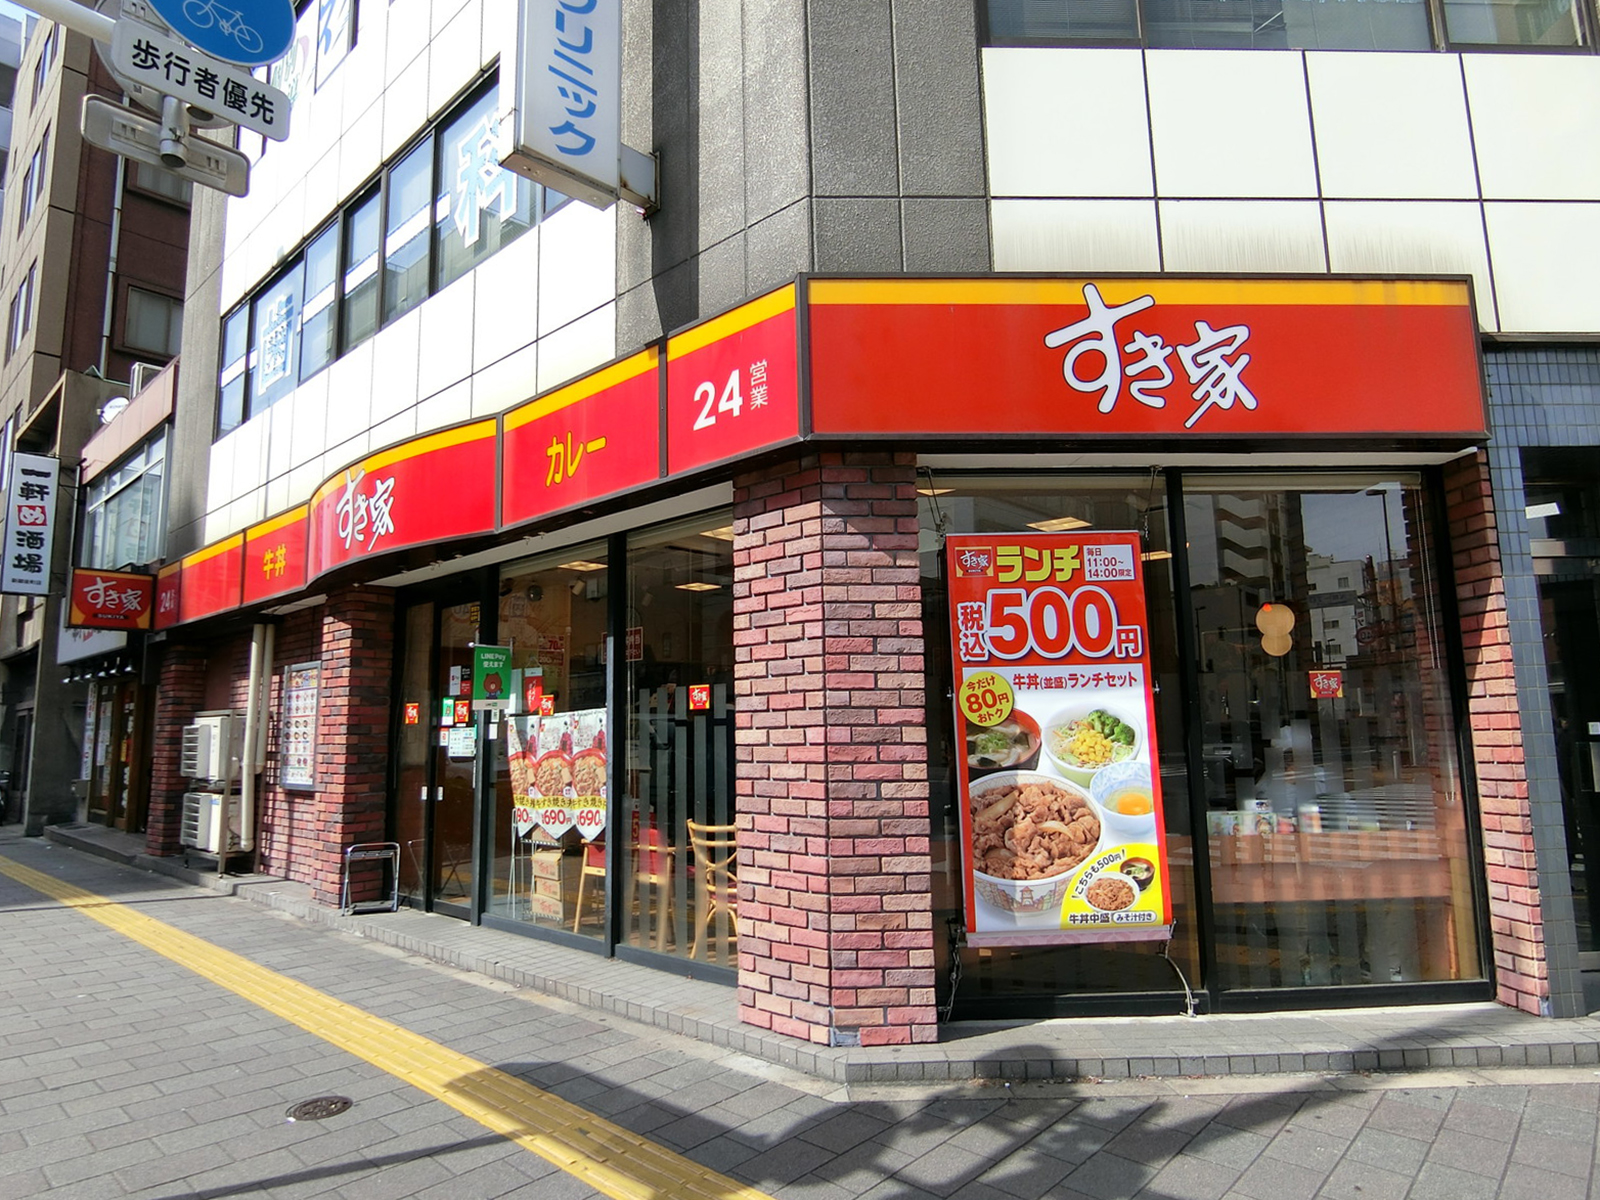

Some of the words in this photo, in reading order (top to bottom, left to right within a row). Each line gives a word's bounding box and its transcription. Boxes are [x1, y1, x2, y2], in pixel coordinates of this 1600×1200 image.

[132, 38, 275, 126] 歩行者優先
[1044, 282, 1259, 429] すき家
[693, 368, 744, 431] 24
[750, 358, 769, 411] 営業
[545, 430, 607, 487] カレー
[12, 468, 51, 573] 一軒め酒場
[335, 468, 396, 552] すき家
[262, 544, 287, 580] 牛丼
[960, 549, 989, 569] すき家
[995, 544, 1081, 582] ランチ
[1087, 547, 1102, 556] 毎日
[83, 576, 143, 614] すき家
[958, 602, 988, 660] 税込
[986, 586, 1142, 658] 500円
[966, 675, 996, 692] 今だけ
[1013, 671, 1137, 691] 牛丼(並盛)ランチセット
[1314, 673, 1338, 690] すき家
[965, 689, 1010, 714] 80円
[977, 708, 1004, 724] おトク
[1069, 913, 1110, 924] 牛丼中盛
[1116, 913, 1152, 922] みそ汁付き
